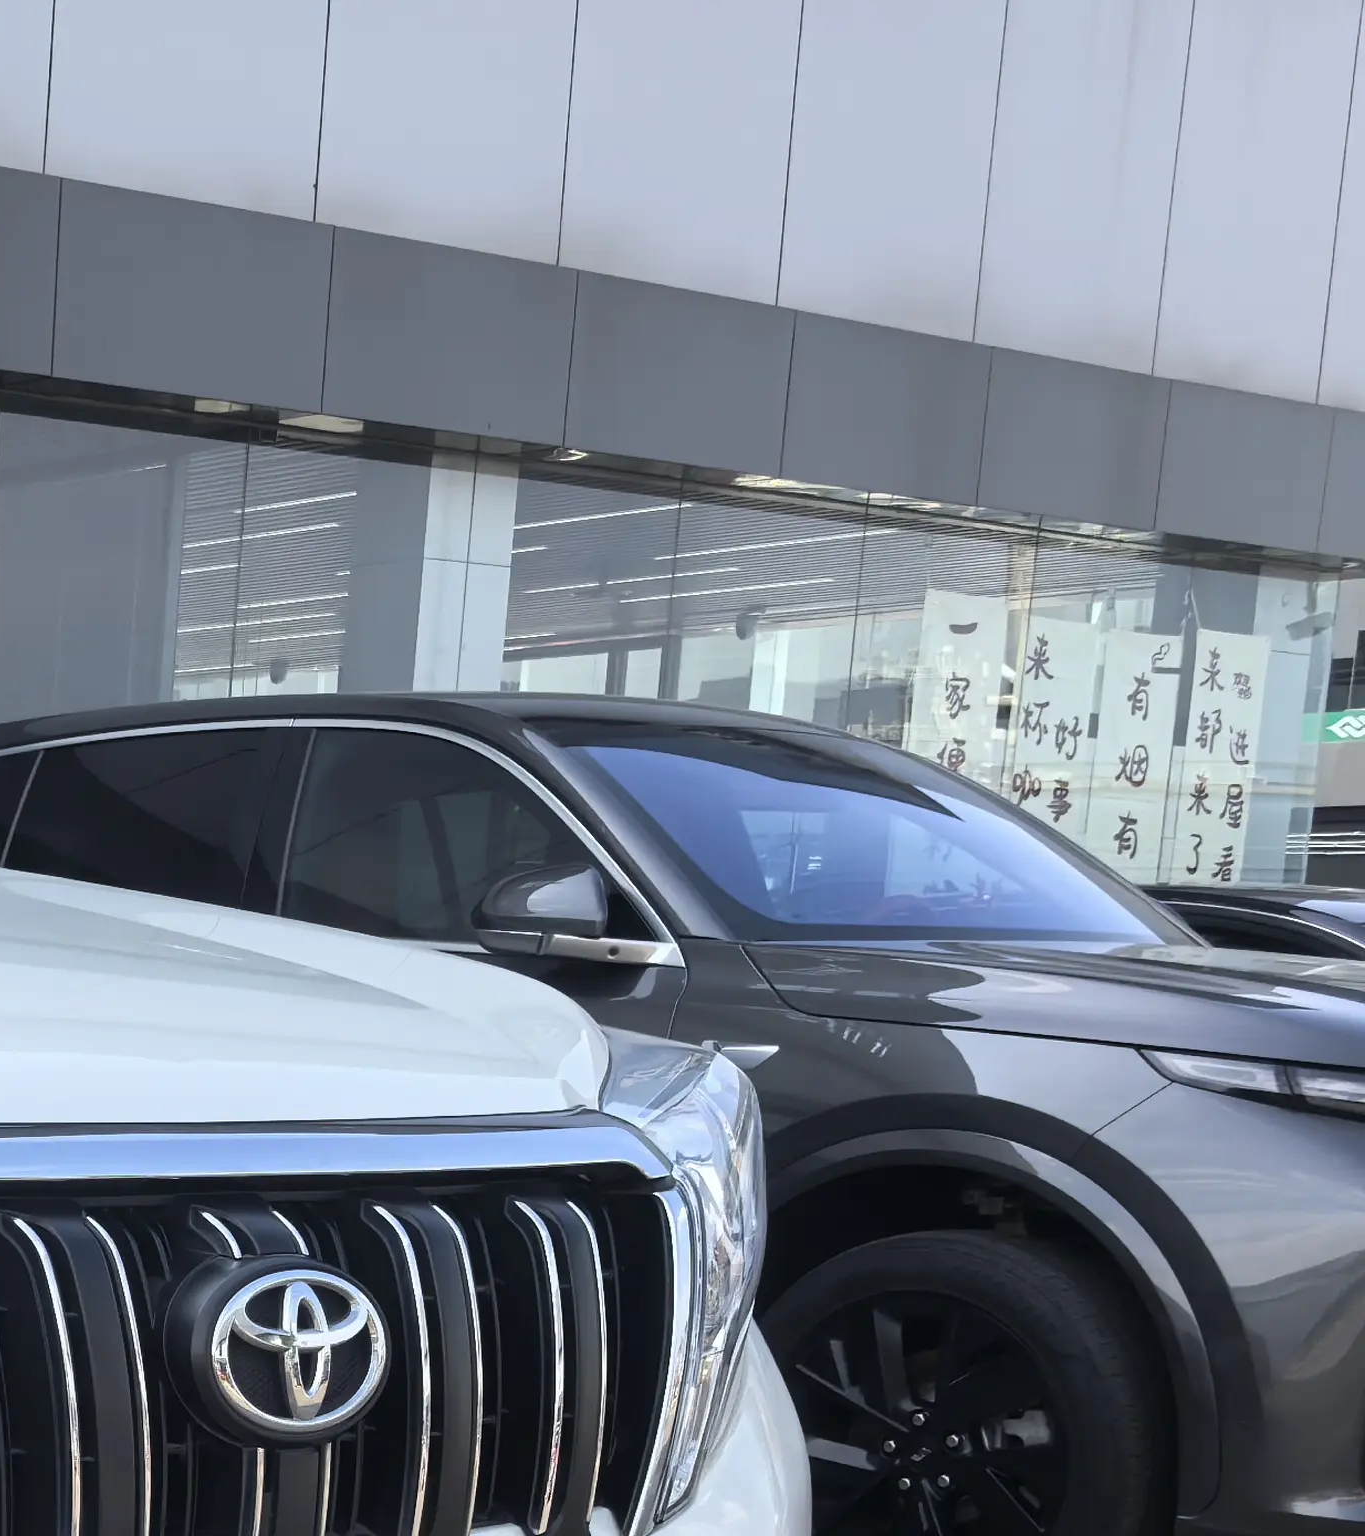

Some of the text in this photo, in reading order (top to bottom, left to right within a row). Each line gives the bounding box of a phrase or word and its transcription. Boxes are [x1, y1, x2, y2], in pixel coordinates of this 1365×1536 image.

[1113, 672, 1151, 859] 有烟有
[1186, 647, 1224, 875] 来都来了
[1211, 725, 1249, 882] 进屋看
